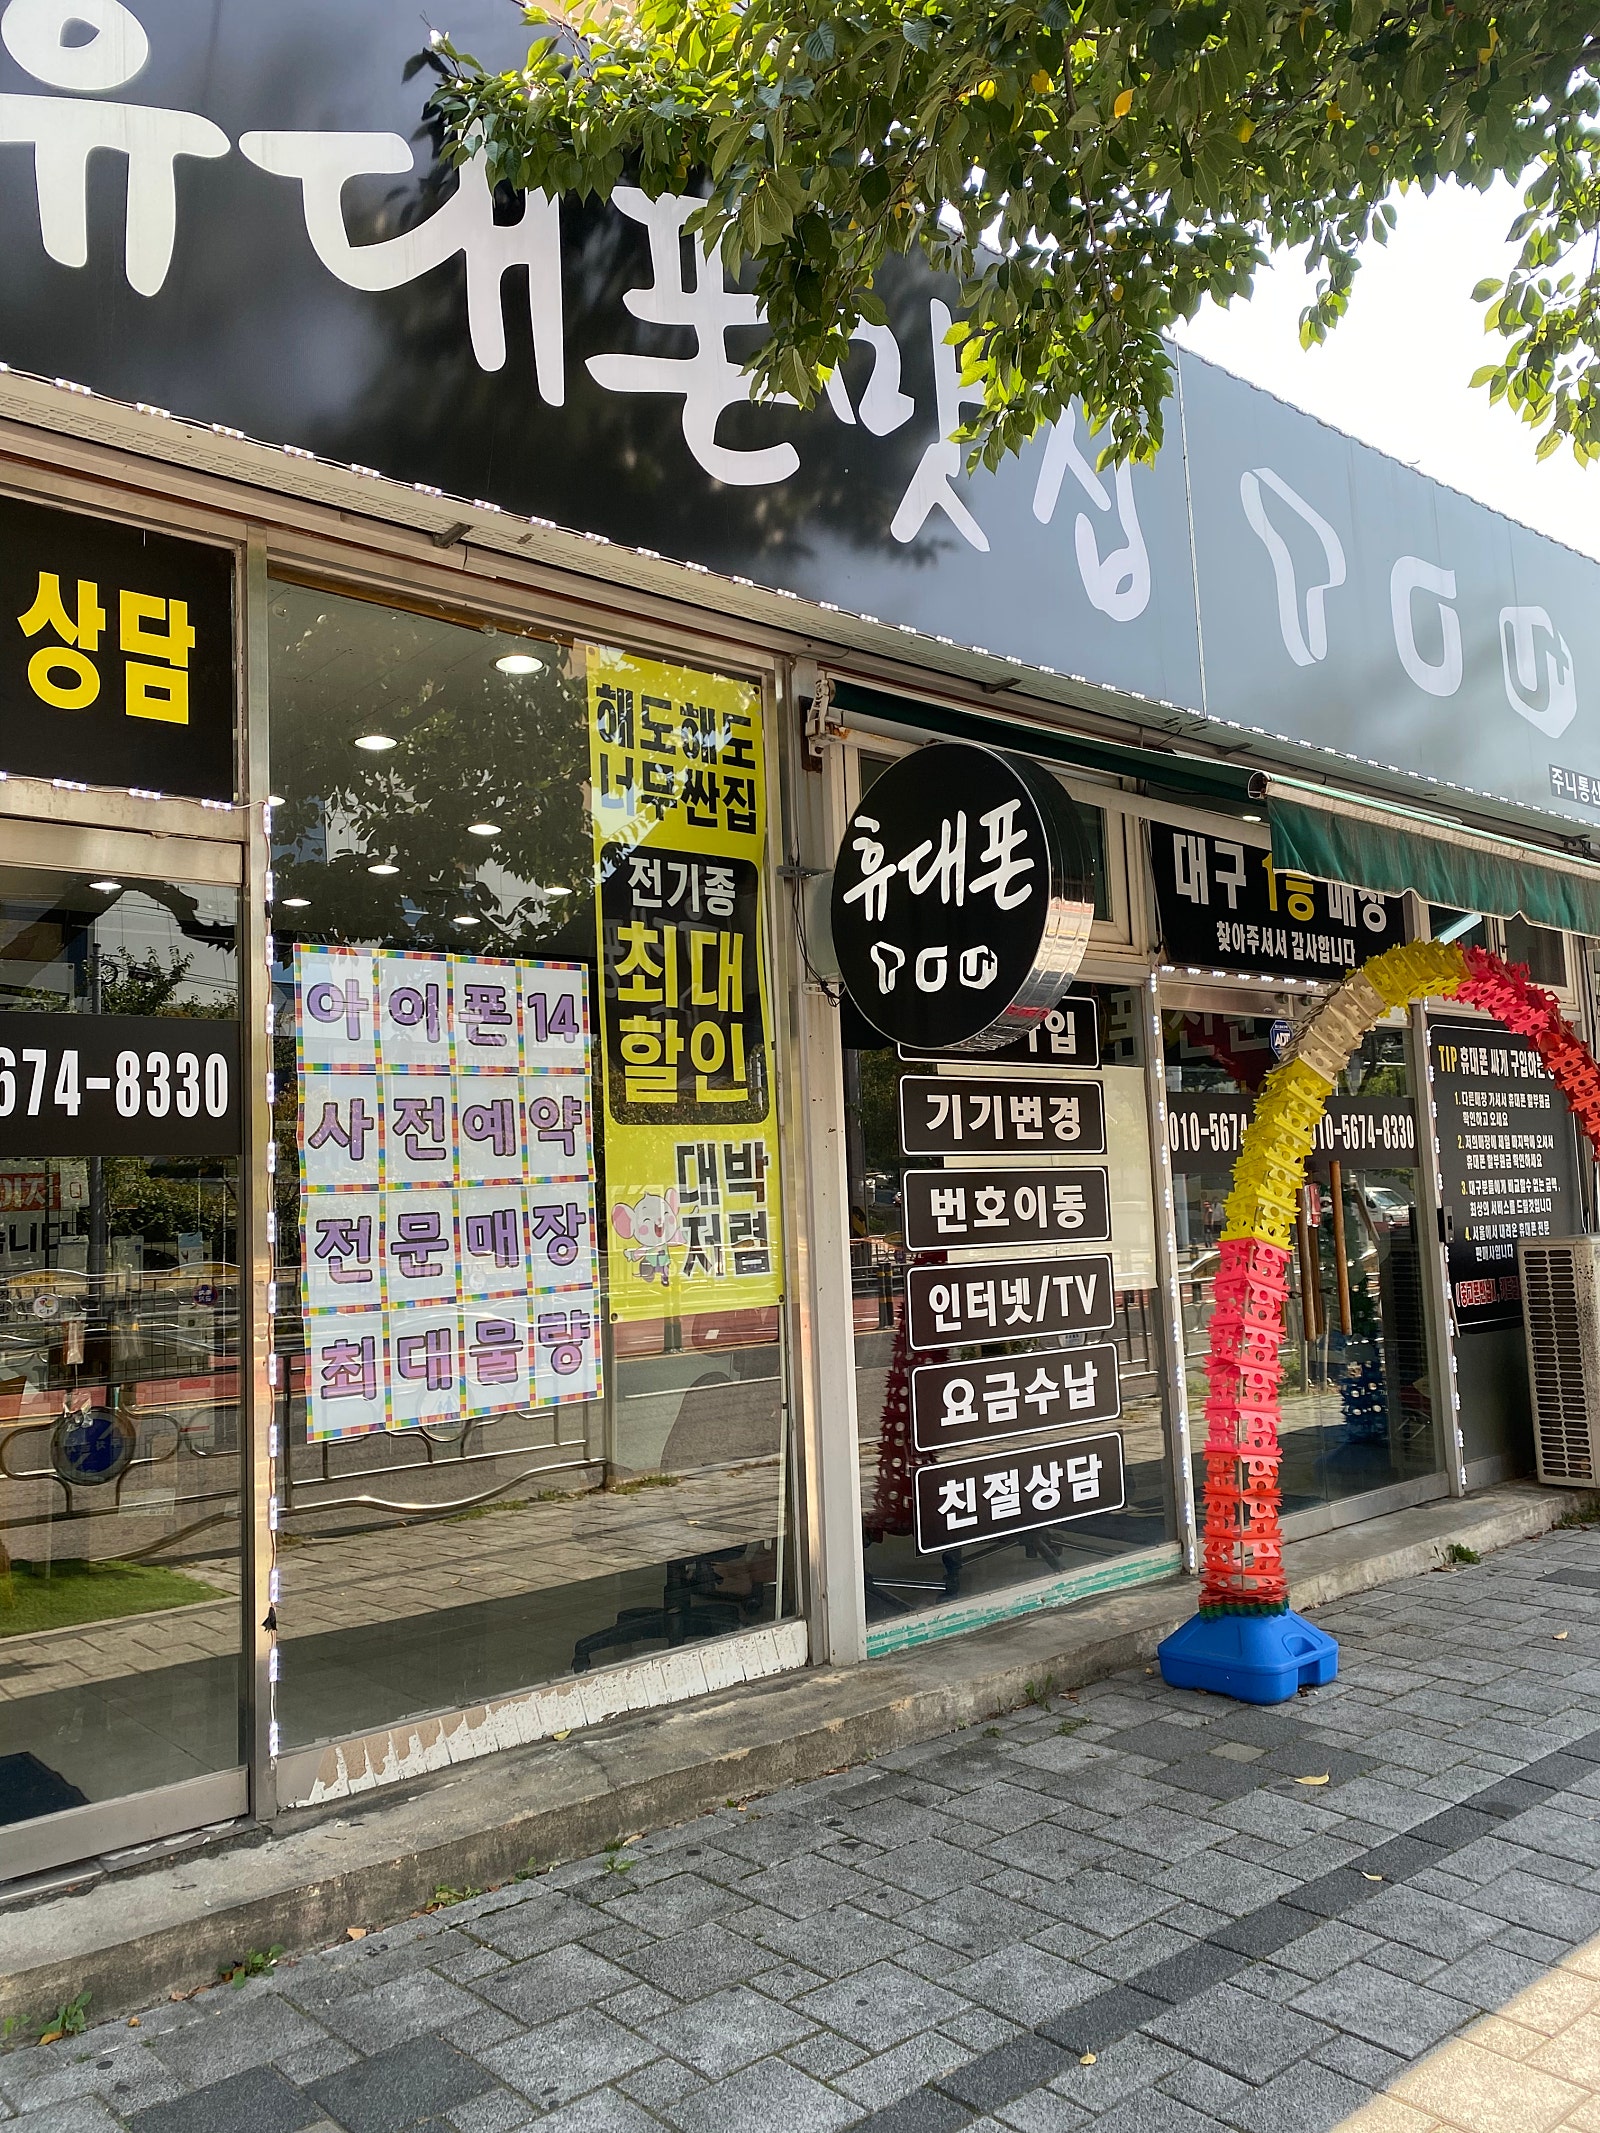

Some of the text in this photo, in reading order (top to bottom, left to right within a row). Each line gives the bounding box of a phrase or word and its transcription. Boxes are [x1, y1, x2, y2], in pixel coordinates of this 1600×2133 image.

[17, 571, 196, 725] 상담
[596, 683, 756, 770] 해도해도
[600, 753, 757, 835] 너무싼집
[628, 857, 736, 917] 전기종
[843, 799, 1035, 922] 휴대폰
[1173, 833, 1247, 910] 대구
[614, 921, 745, 1013] 최대
[1216, 921, 1356, 967] 찾아주셔서 감사합니다
[620, 1015, 749, 1103] 할인
[1438, 1045, 1457, 1072] TIP
[1460, 1046, 1489, 1076] 휴대폰
[1490, 1048, 1509, 1077] 싸게
[1510, 1050, 1545, 1079] 구입하는
[308, 1095, 583, 1161] 사전예약
[926, 1094, 1081, 1141] 기기변경
[1454, 1091, 1461, 1106] 1.
[1508, 1093, 1526, 1108] 휴대폰
[1527, 1094, 1550, 1109] 할부원금
[1462, 1112, 1509, 1127] 확인하고 오세요
[676, 1141, 769, 1207] 대박
[1457, 1135, 1465, 1150] 2.
[1498, 1135, 1510, 1150] 제일
[1511, 1135, 1535, 1150] 마지막에
[1466, 1153, 1543, 1170] 휴대폰 할부원금 확인하세요
[930, 1185, 1087, 1233] 번호이동
[1461, 1181, 1468, 1196] 3.
[1468, 1180, 1507, 1196] 대구분들에게
[1533, 1178, 1545, 1193] 없는
[1470, 1201, 1489, 1217] 최상의
[1491, 1199, 1515, 1216] 서비스를
[313, 1203, 586, 1284] 전문매장
[682, 1211, 770, 1277] 저렴
[1464, 1221, 1550, 1241] 4. 서울에서 내려온 휴대폰 전문
[1475, 1243, 1514, 1262] 판매사입니다
[929, 1273, 1097, 1332] 인터넷/TV
[320, 1310, 590, 1401] 최대물량
[940, 1361, 1098, 1427] 요금수납
[938, 1453, 1103, 1530] 친절상담
